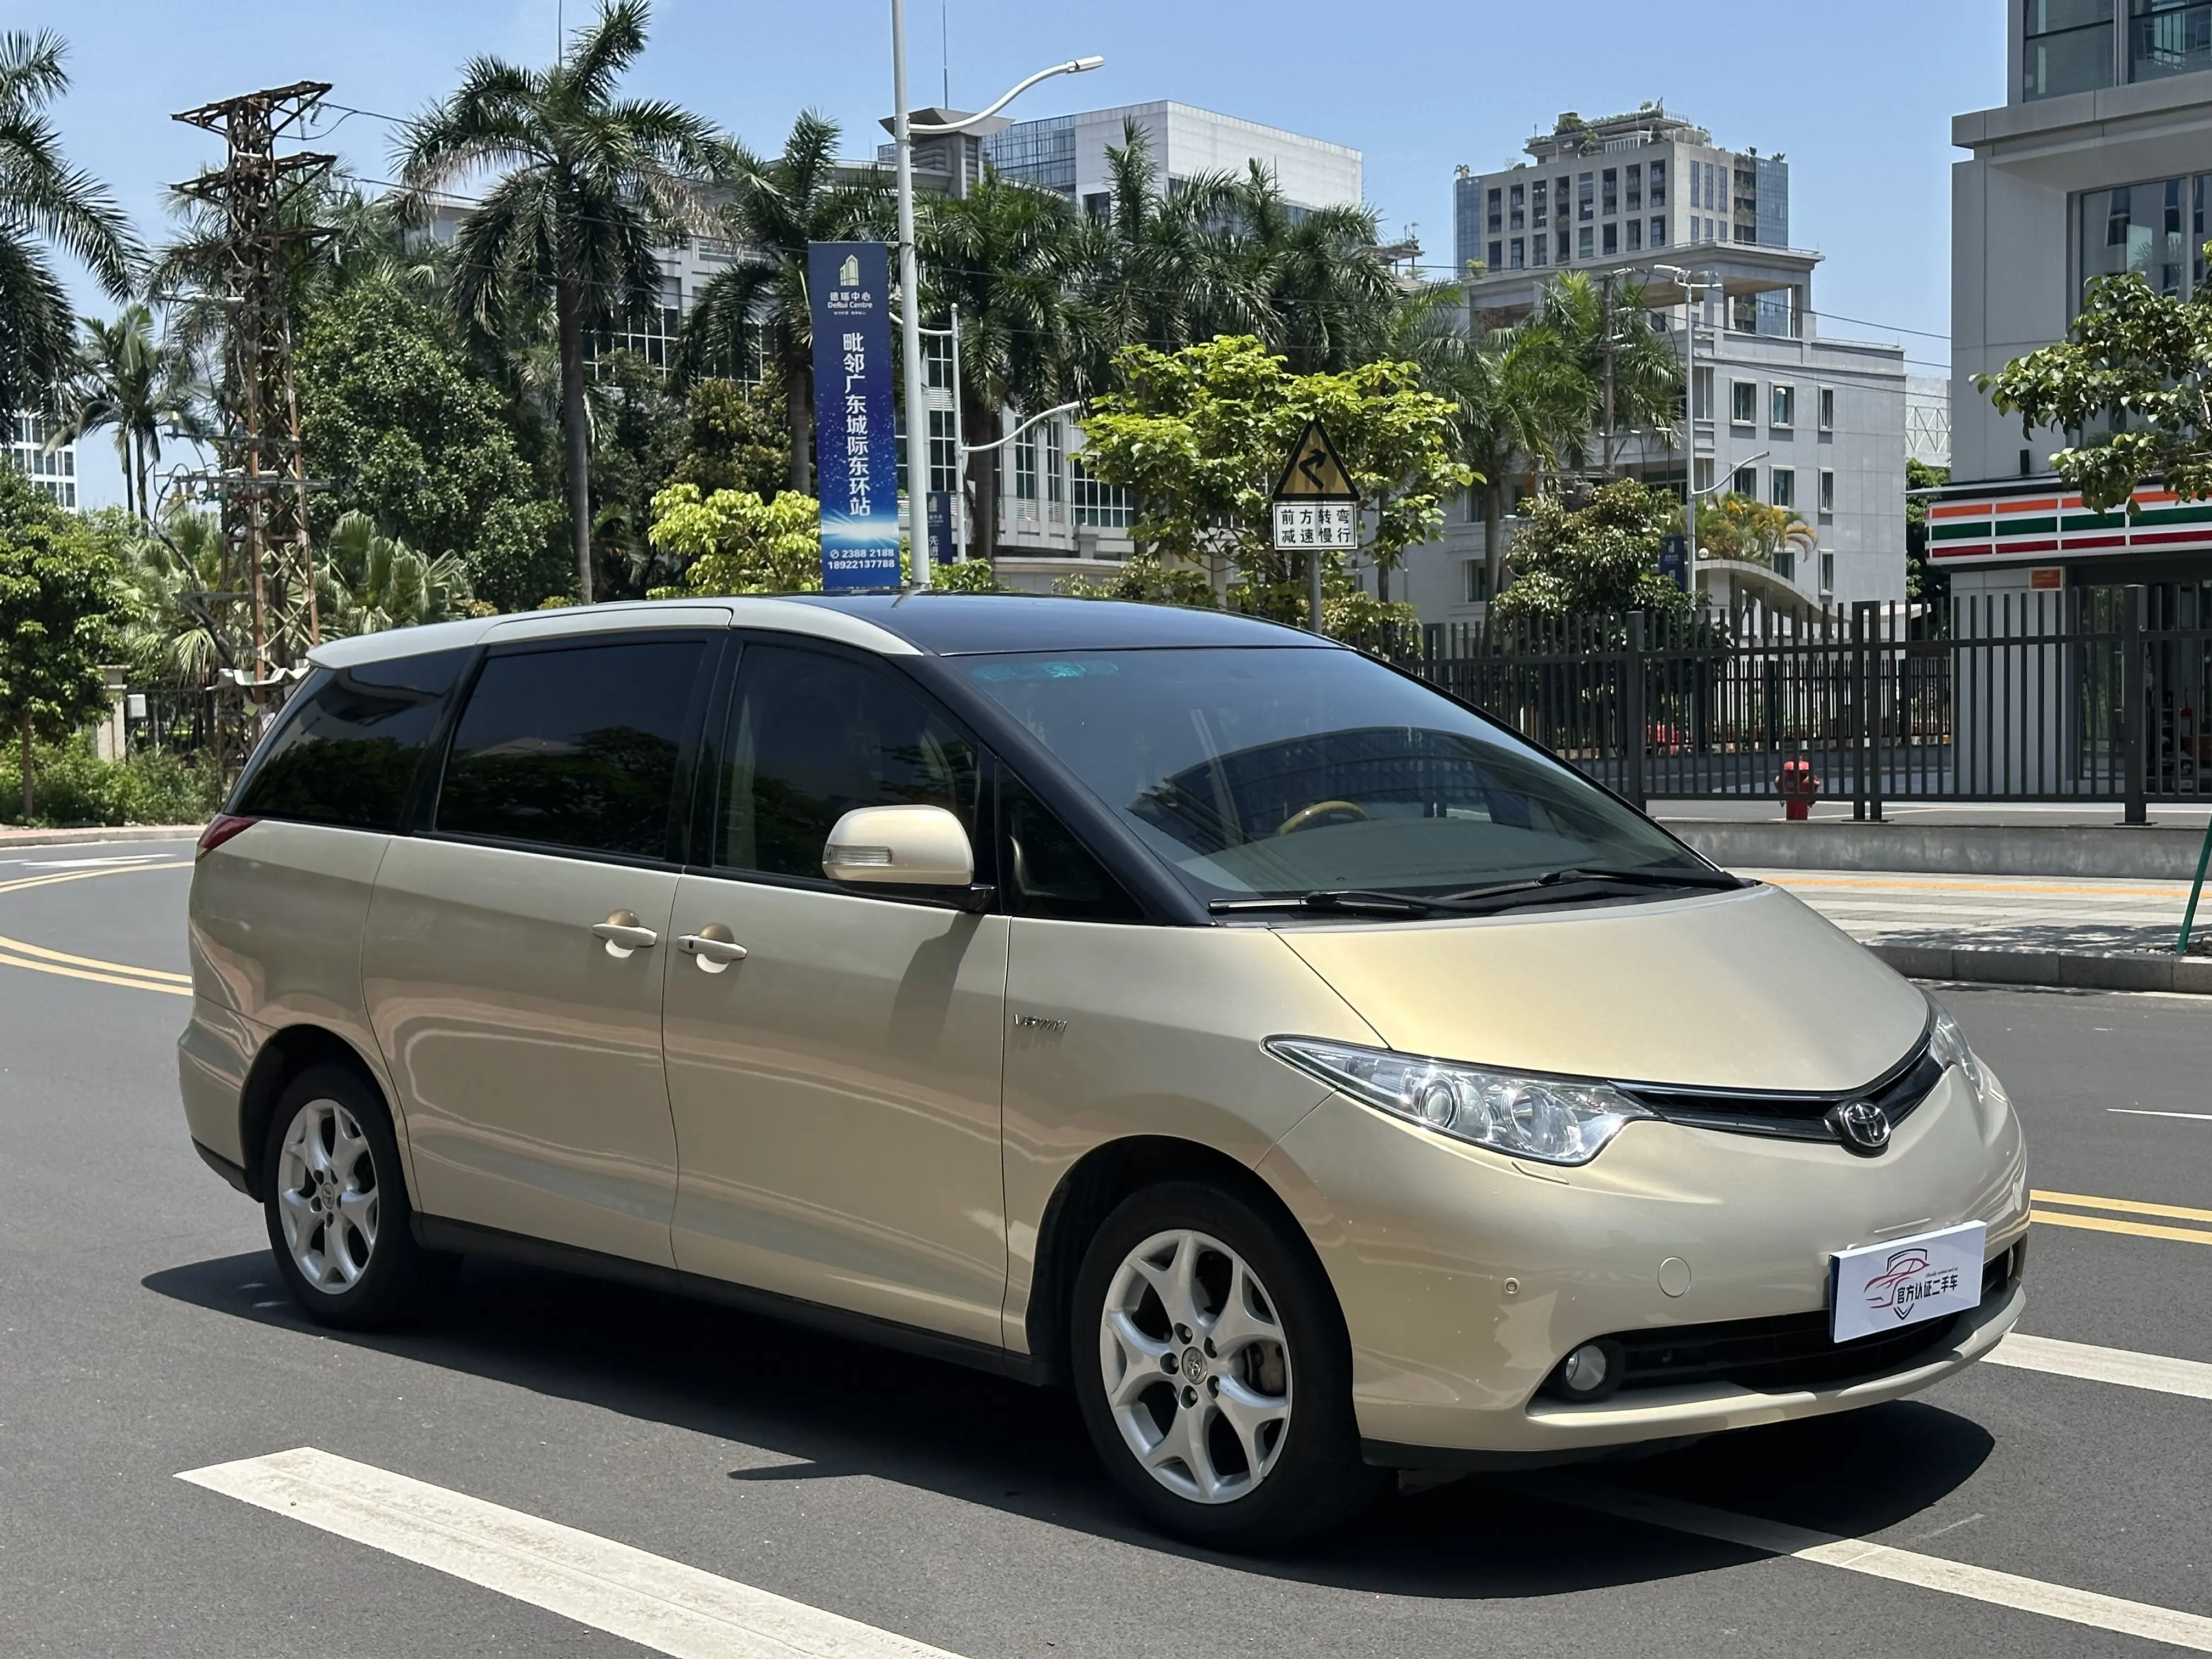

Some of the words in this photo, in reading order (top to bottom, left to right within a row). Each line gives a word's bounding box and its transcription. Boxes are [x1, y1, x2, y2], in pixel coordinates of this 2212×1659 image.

[843, 332, 871, 516] 毗邻广东城际东环站
[1280, 509, 1350, 524] 前方转弯
[1282, 528, 1351, 543] 减速慢行
[842, 549, 867, 558] 2388
[869, 549, 894, 557] 2188
[827, 560, 895, 569] 18922137788
[1898, 1274, 1958, 1304] 官方认证二手车
